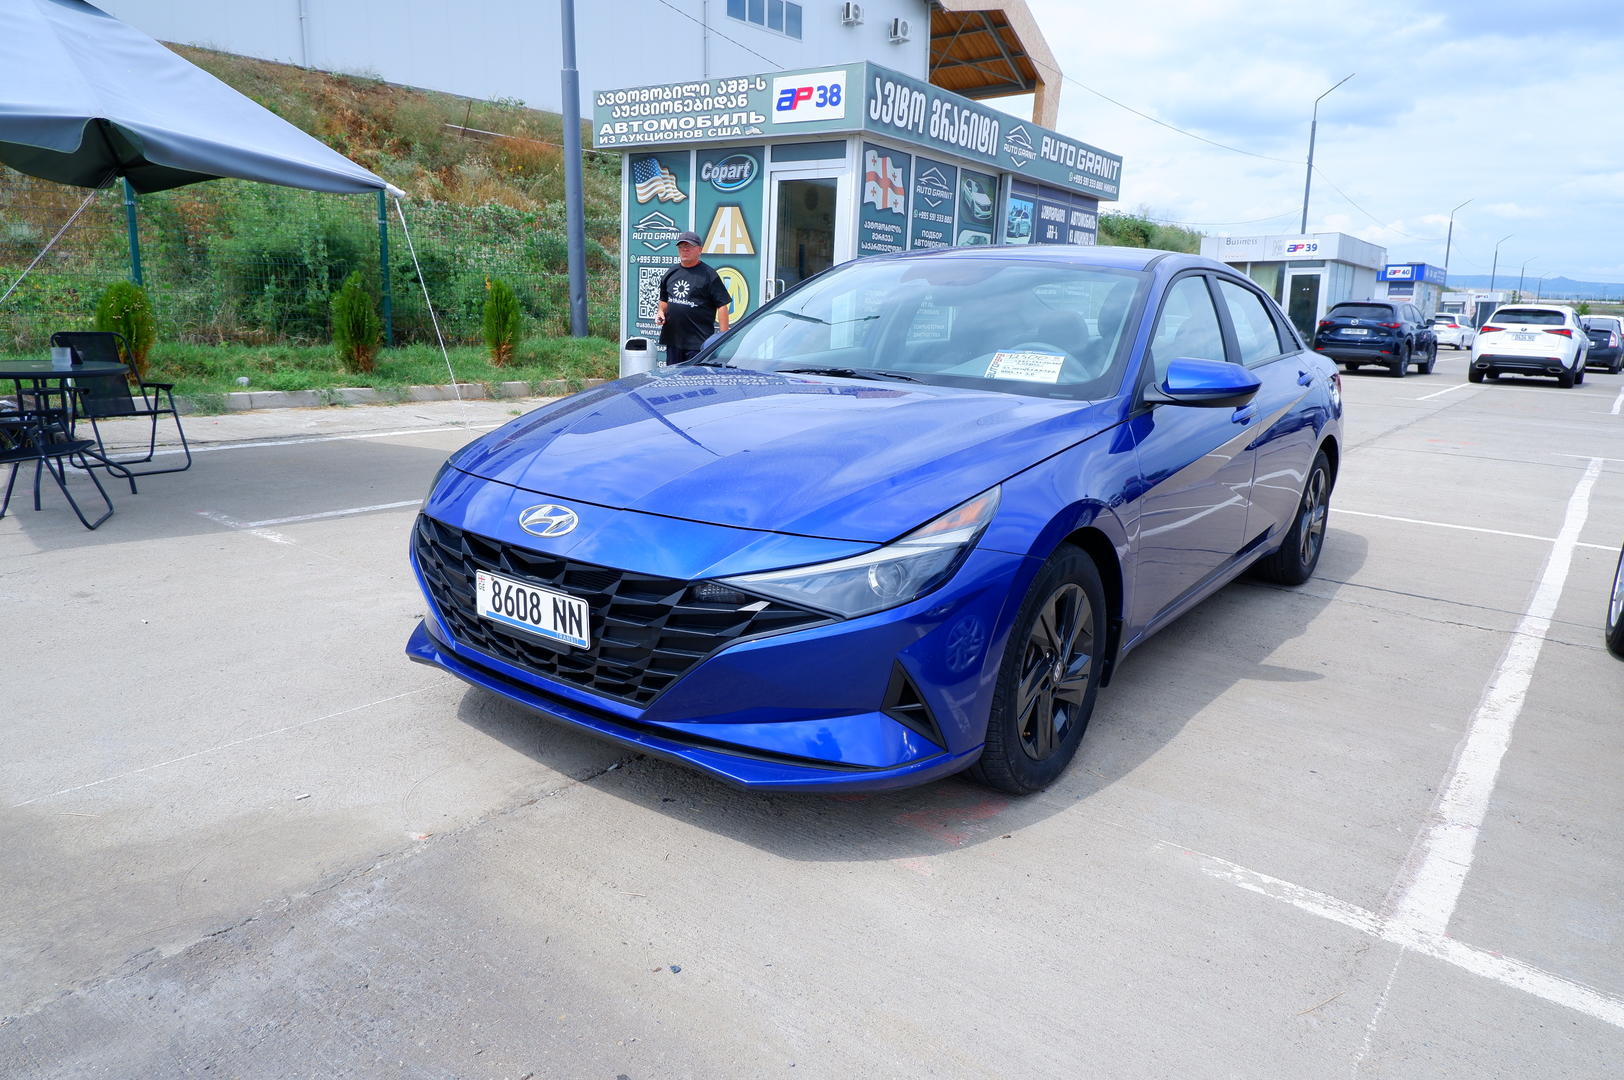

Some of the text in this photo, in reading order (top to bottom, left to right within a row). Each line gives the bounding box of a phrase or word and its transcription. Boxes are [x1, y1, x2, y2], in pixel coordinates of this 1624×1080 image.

[597, 77, 767, 106] ავტომობილი აშშ-ს
[815, 83, 842, 108] 38
[612, 94, 748, 118] აუქციონებიდან
[870, 77, 1000, 156] ავტო გრანიტი
[600, 112, 766, 135] АВТОМОБИЛЬ
[600, 127, 742, 144] ИЗ АУКЦИОНОВ США
[1003, 143, 1037, 160] AUTO GRANIT
[1041, 135, 1120, 180] AUTO GRANIT
[701, 160, 751, 183] Copart
[916, 185, 953, 200] AUTO GRANIT
[632, 232, 681, 241] AUTO GRANI
[1305, 243, 1318, 252] 39
[636, 255, 650, 263] +995
[651, 255, 660, 263] 591
[492, 580, 583, 638] 8608 NN
